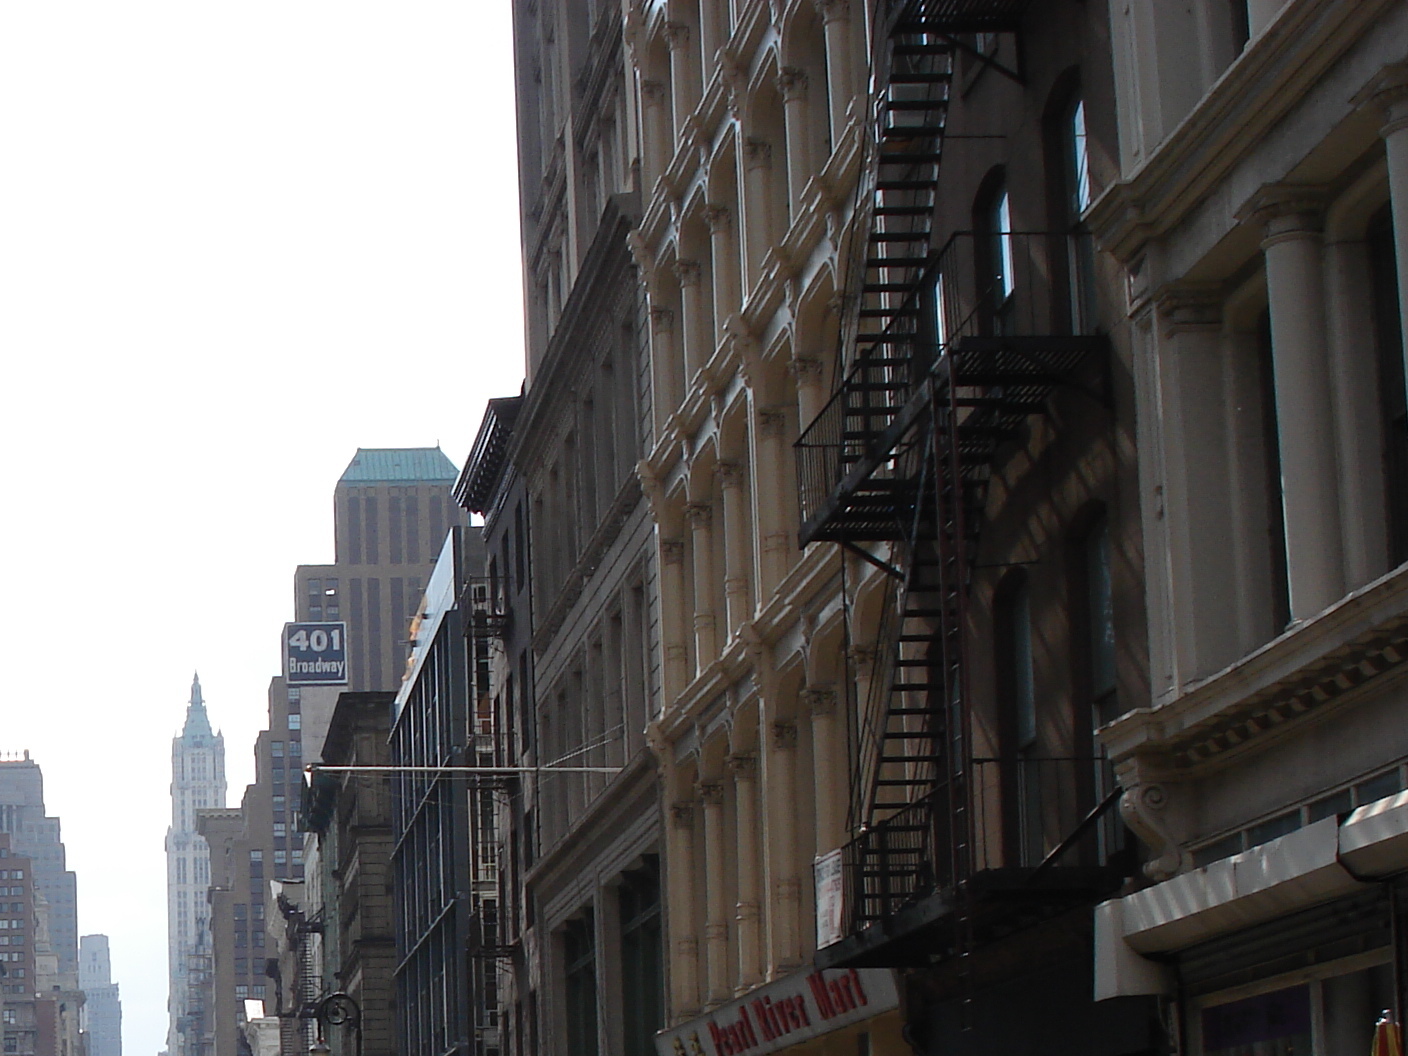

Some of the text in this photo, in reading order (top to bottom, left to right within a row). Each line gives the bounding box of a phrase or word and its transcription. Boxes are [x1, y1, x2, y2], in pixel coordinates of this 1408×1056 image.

[289, 629, 341, 652] 401
[289, 656, 344, 677] Broadway
[750, 995, 811, 1042] River
[805, 967, 868, 1021] Mart
